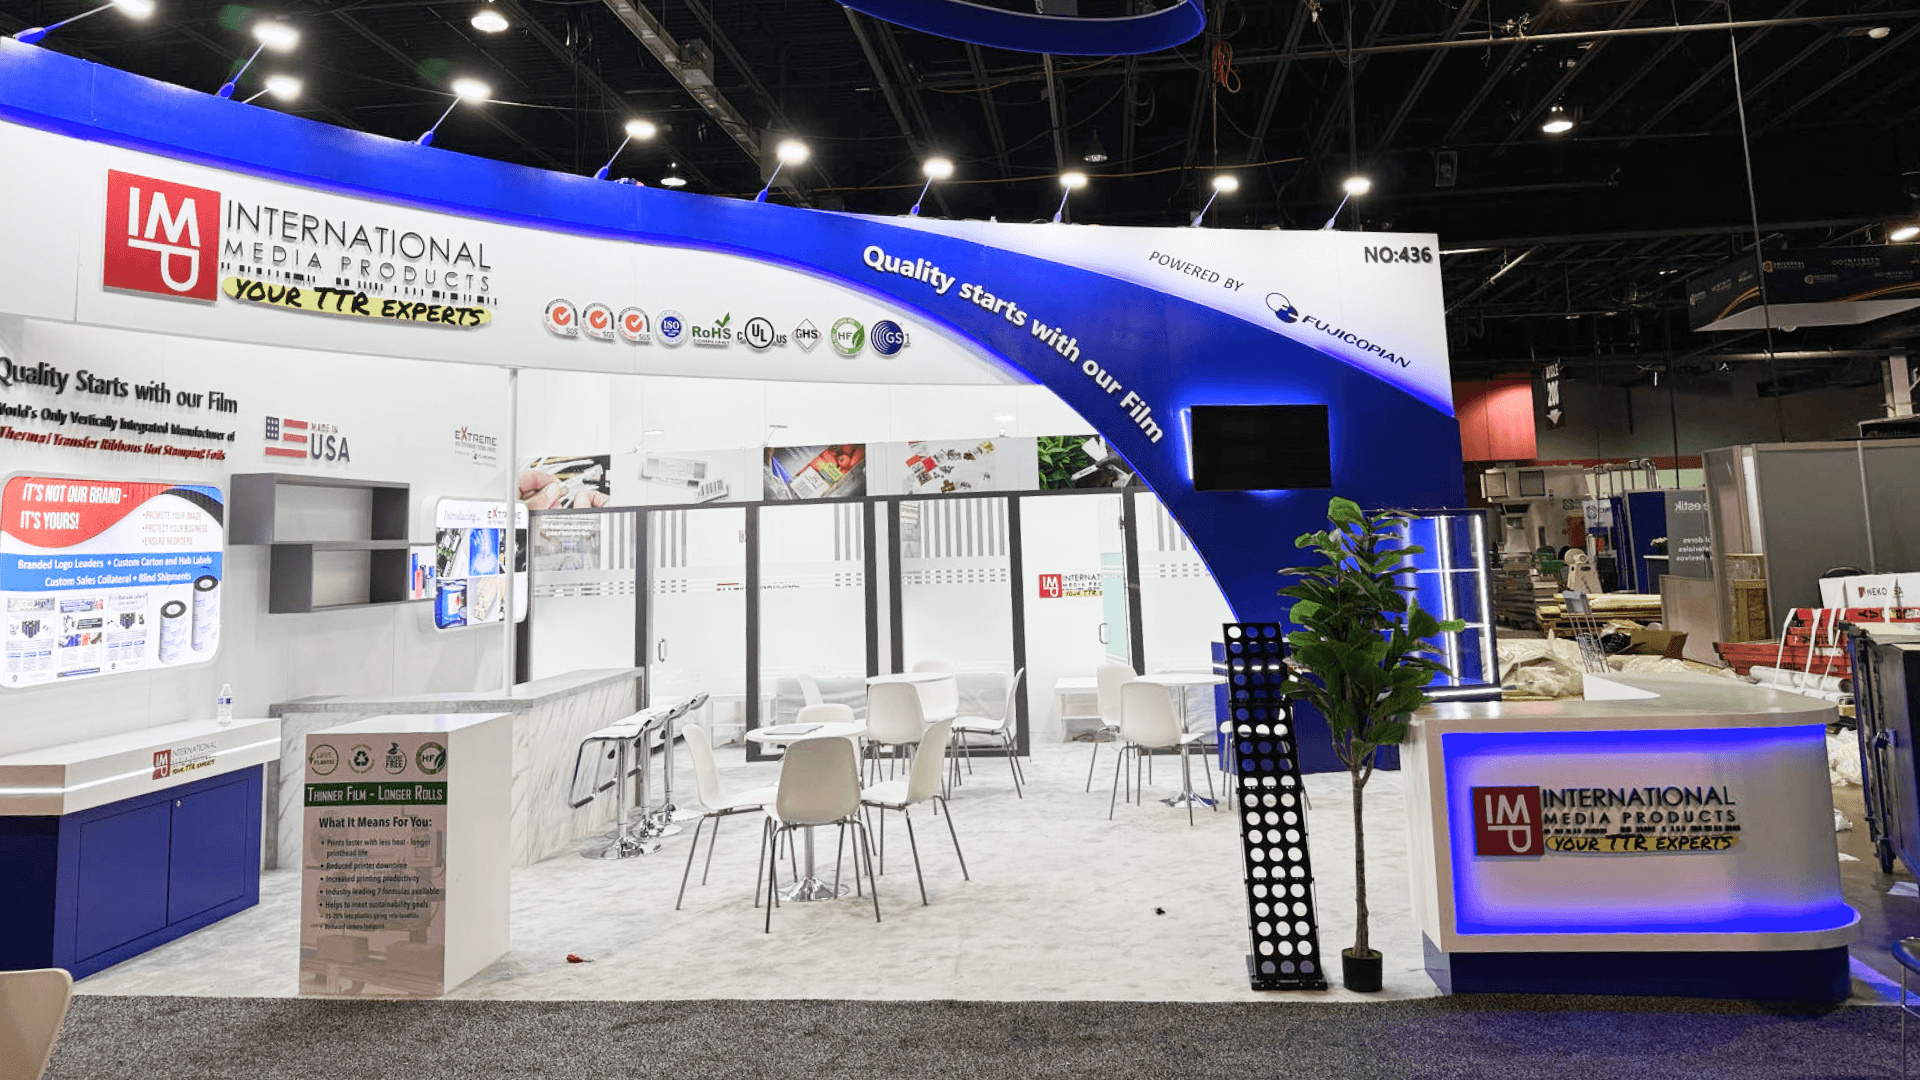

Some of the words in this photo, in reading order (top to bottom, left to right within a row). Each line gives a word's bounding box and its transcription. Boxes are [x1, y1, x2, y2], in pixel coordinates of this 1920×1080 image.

[227, 199, 492, 271] INTERNATIONAL
[1364, 246, 1433, 263] NO:436
[224, 239, 322, 270] MEDIA
[340, 256, 489, 292] PRODUCTS
[1149, 250, 1220, 284] POWERED
[1224, 277, 1244, 292] BY
[234, 278, 302, 308] YOUR
[313, 287, 370, 317] TTR
[381, 299, 485, 327] EXPERTS
[565, 327, 579, 336] SGS
[664, 320, 679, 330] ISO
[602, 331, 615, 339] SGS
[639, 333, 652, 341] SGS
[692, 326, 731, 340] RoHS
[796, 328, 818, 339] GHS
[838, 332, 852, 340] HF
[886, 332, 911, 346] GS1
[863, 245, 955, 295] Quality
[958, 282, 1028, 327] starts
[1031, 318, 1081, 364] with
[1082, 359, 1123, 394] our
[1119, 391, 1164, 443] Film
[1301, 315, 1411, 368] FUJICOPIAN
[0, 356, 69, 395] Quality
[75, 369, 129, 398] Starts
[135, 381, 171, 404] with
[176, 390, 204, 409] our
[208, 391, 238, 413] Film
[41, 407, 67, 425] Only
[70, 411, 118, 431] Vertically
[120, 417, 169, 434] Integrated
[171, 423, 226, 441] Manufacturer
[227, 431, 236, 442] of
[311, 422, 330, 433] MADE
[331, 425, 339, 434] IN
[0, 425, 52, 445] Thermal
[53, 433, 99, 449] Transfer
[100, 438, 142, 454] Ribbons
[143, 442, 163, 455] Hot
[163, 445, 205, 460] Stamping
[206, 448, 226, 461] Foils
[454, 426, 498, 447] EXTREME
[310, 432, 350, 462] USA
[22, 483, 44, 502] IT'S
[45, 485, 66, 502] NOT
[67, 486, 88, 503] OUR
[89, 487, 121, 504] BRAND
[20, 510, 41, 529] IT'S
[42, 511, 79, 530] YOURS!
[18, 559, 52, 570] Branded
[55, 559, 73, 571] Logo
[75, 558, 103, 569] Leaders
[113, 558, 140, 568] Custom
[141, 557, 163, 567] Carton
[165, 557, 177, 566] and
[179, 556, 191, 565] Hub
[193, 555, 212, 565] Labels
[45, 576, 75, 587] Custom
[77, 575, 96, 586] Sales
[98, 574, 132, 585] Collateral
[139, 573, 156, 583] Blind
[157, 572, 191, 583] Shipments
[386, 760, 403, 769] FREE
[422, 754, 435, 763] HF
[307, 786, 343, 802] THINNER
[346, 785, 366, 801] FILM
[378, 785, 411, 800] LONGER
[414, 784, 442, 800] ROLLS
[1542, 786, 1735, 808] INTERNATIONAL
[319, 817, 345, 828] What
[347, 817, 355, 828] It
[357, 816, 390, 828] Means
[393, 816, 408, 827] For
[410, 816, 432, 828] You:
[1544, 812, 1611, 824] MEDIA
[1623, 810, 1736, 823] PRODUCTS
[327, 839, 345, 847] Prints
[345, 838, 363, 847] faster
[364, 838, 377, 847] with
[379, 838, 392, 847] less
[393, 838, 405, 847] heat
[410, 838, 431, 849] longer
[1554, 838, 1600, 851] YOUR
[1605, 834, 1648, 851] TTR
[1656, 835, 1733, 850] EXPERTS
[326, 849, 357, 859] printhead
[358, 848, 368, 857] life
[327, 862, 352, 871] Reduced
[354, 862, 375, 872] printer
[376, 861, 408, 870] downtime
[326, 875, 355, 883] Increased
[357, 874, 382, 884] printing
[382, 874, 420, 884] productivity
[325, 888, 351, 898] Industry
[352, 887, 376, 898] leading
[411, 887, 440, 896] available
[325, 901, 342, 911] Helps
[351, 901, 367, 909] meet
[369, 900, 410, 910] sustainability
[411, 900, 428, 910] goals
